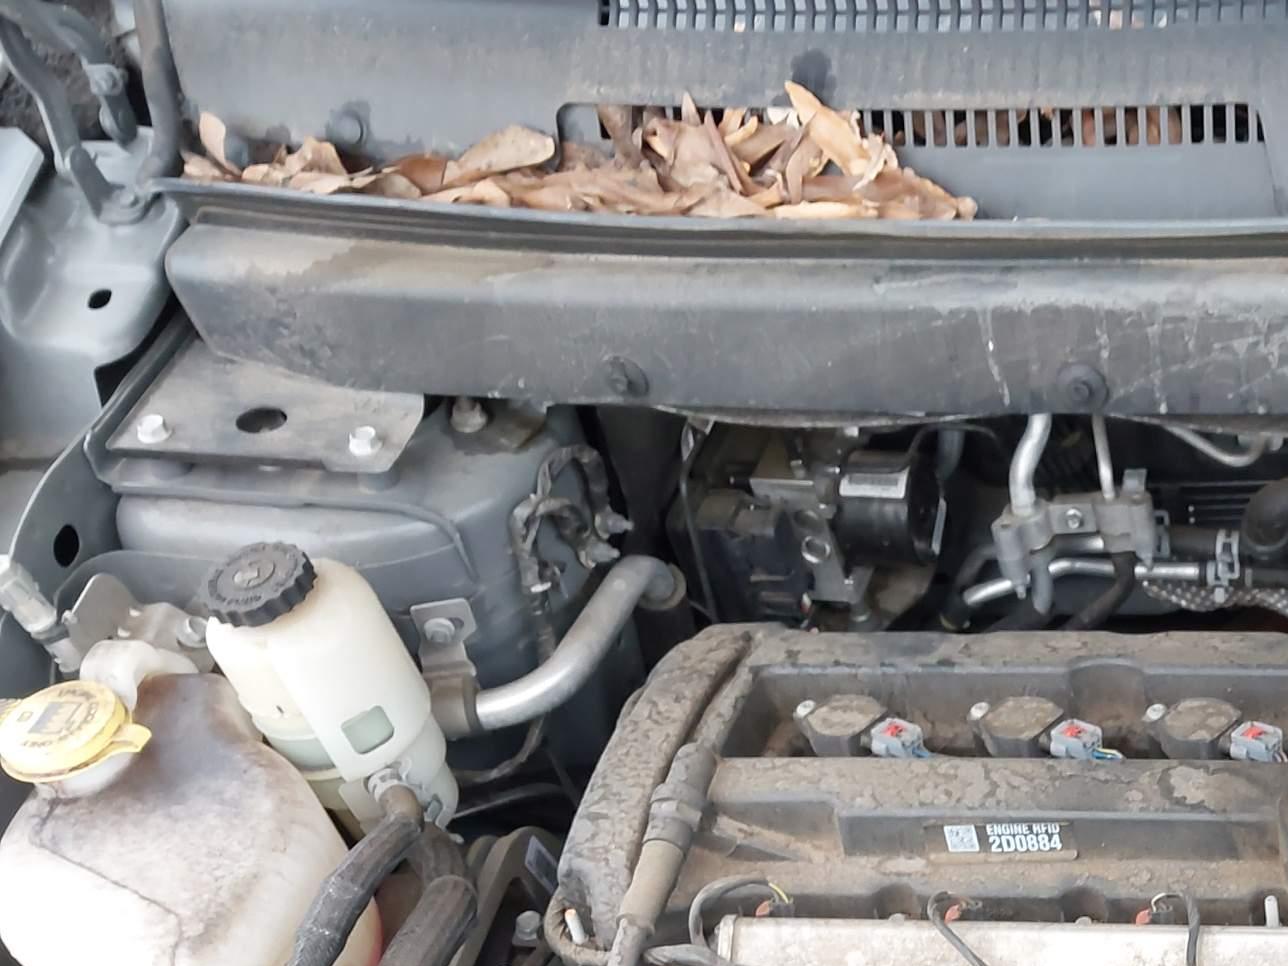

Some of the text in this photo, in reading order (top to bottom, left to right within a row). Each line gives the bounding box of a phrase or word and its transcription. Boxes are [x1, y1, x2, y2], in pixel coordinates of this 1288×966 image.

[986, 823, 1060, 835] ENGINE RFID
[988, 834, 1062, 852] 2D0884
